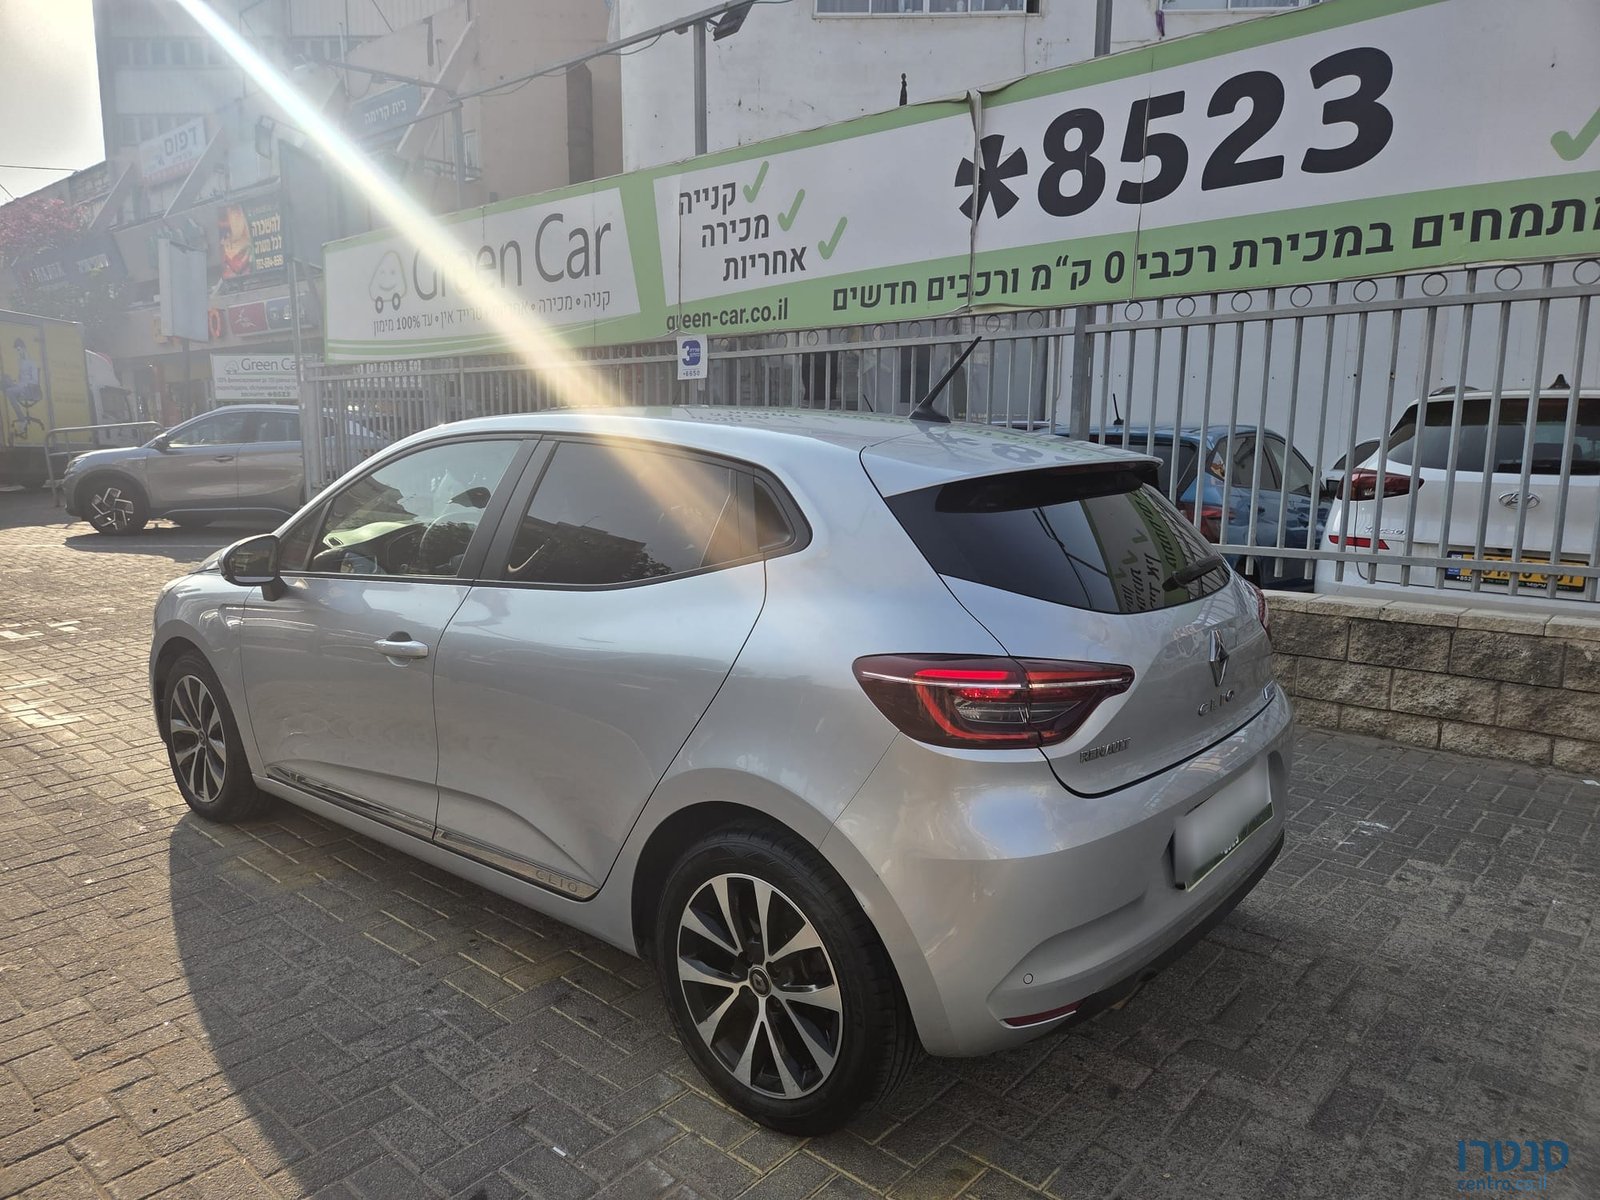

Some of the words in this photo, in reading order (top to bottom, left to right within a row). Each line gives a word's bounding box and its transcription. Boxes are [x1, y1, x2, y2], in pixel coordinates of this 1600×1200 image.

[163, 126, 198, 156] דפוס
[678, 181, 736, 215] קנייה
[701, 214, 769, 248] מכירה
[1410, 195, 1600, 246] תמחים
[533, 212, 612, 284] Car
[1233, 220, 1394, 270] במכירת
[722, 246, 807, 282] אחריות
[1136, 244, 1218, 282] רכבי
[832, 280, 918, 311] חדשים
[926, 267, 1020, 302] ורכבים
[539, 295, 573, 314] מכירה
[583, 290, 611, 311] קניה
[666, 297, 787, 333] green-car.co.il
[373, 319, 394, 337] מימון
[396, 315, 420, 331] 100%
[421, 313, 433, 327] עד
[439, 310, 454, 329] אין
[241, 358, 279, 371] Green
[281, 358, 297, 371] Ca
[1198, 689, 1234, 717] CLIO
[1080, 736, 1131, 763] RENAULT
[535, 868, 578, 893] CLIO
